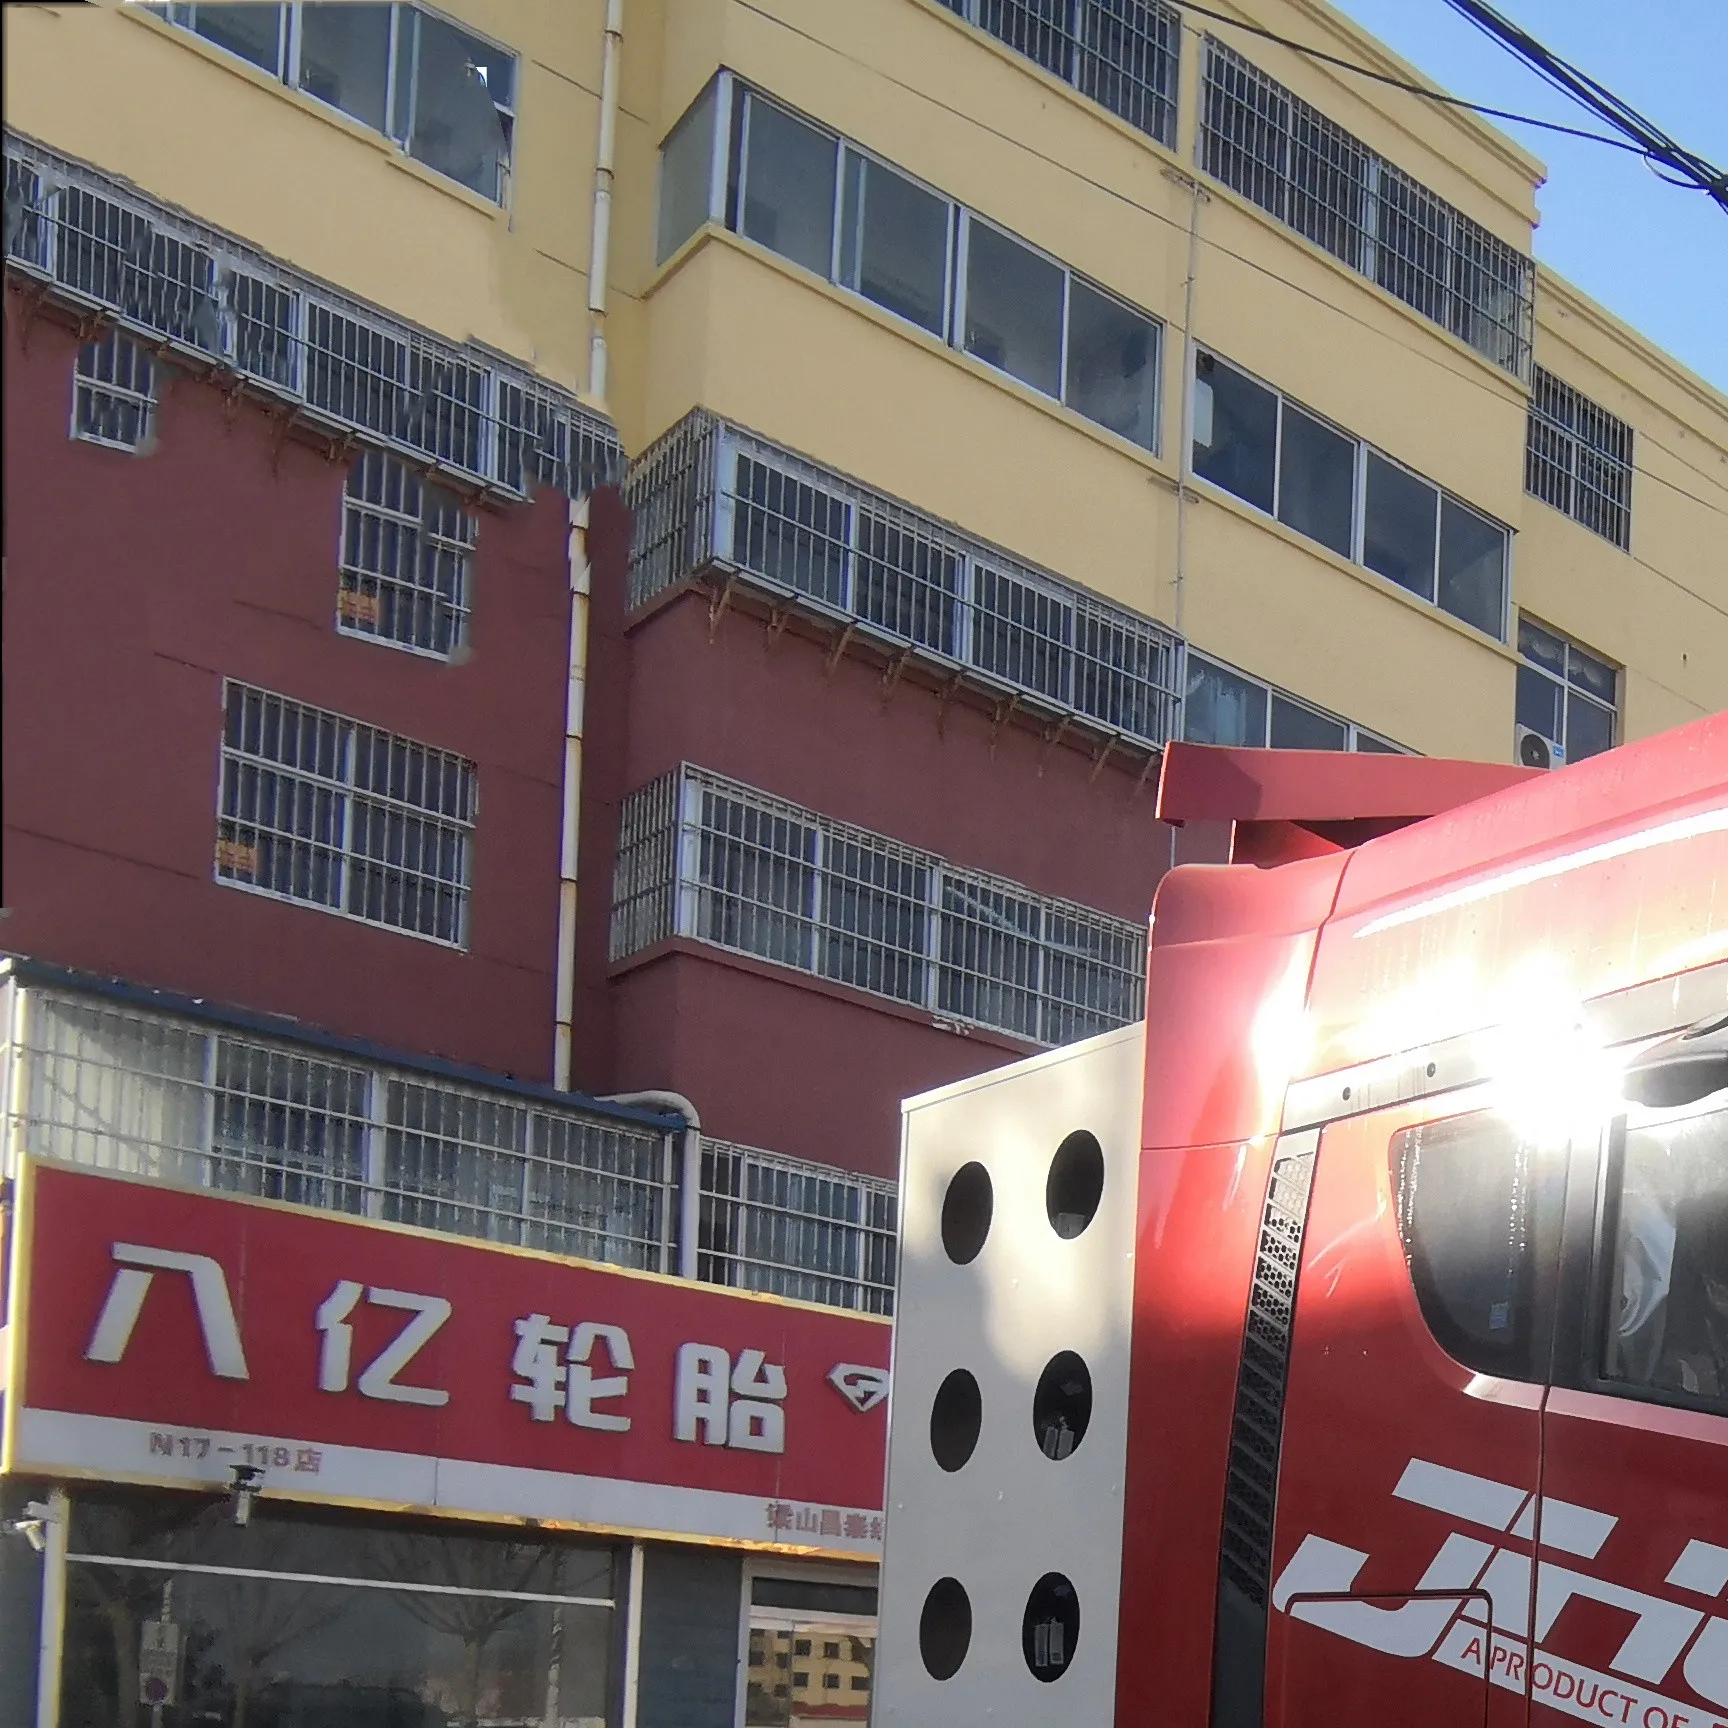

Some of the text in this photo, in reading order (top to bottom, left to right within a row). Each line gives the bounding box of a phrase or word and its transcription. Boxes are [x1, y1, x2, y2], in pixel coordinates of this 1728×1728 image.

[84, 1241, 788, 1454] 八亿轮胎
[1460, 1637, 1483, 1663] A
[1489, 1645, 1638, 1724] PRODUCT
